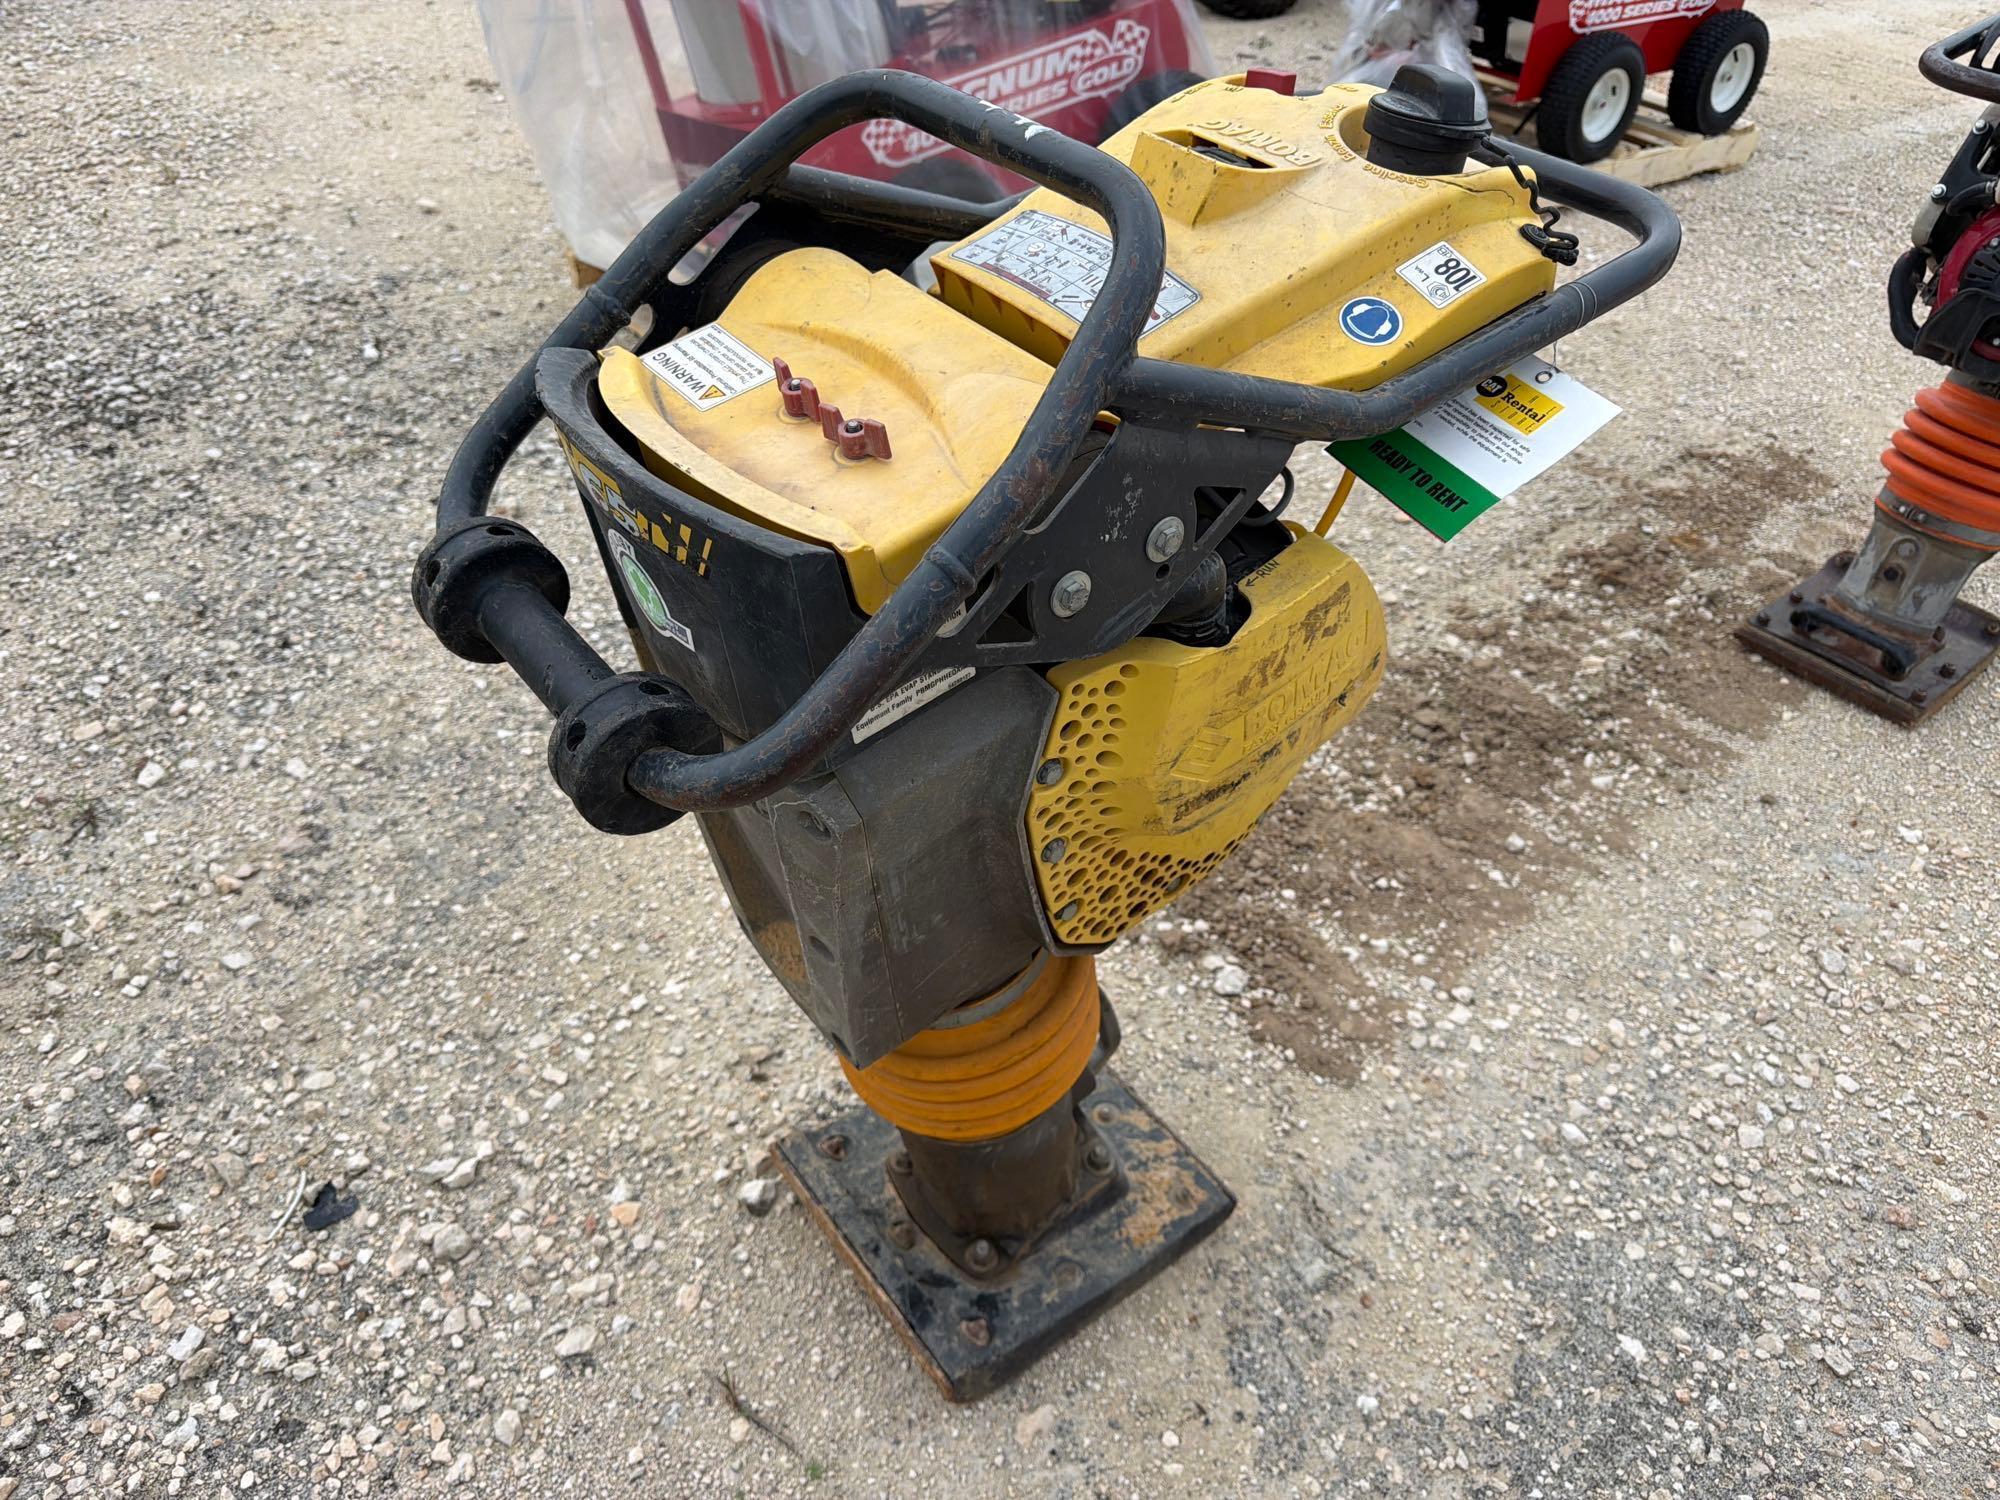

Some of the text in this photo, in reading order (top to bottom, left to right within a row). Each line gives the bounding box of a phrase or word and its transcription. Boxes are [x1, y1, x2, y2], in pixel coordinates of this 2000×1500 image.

[1075, 53, 1137, 90] GOLD
[1199, 117, 1321, 166] BOMAG
[1362, 162, 1430, 189] Gasoline
[1434, 257, 1478, 292] 108
[652, 351, 707, 394] WARNING
[1481, 378, 1503, 394] CAT
[1500, 391, 1547, 424] Rental
[1518, 443, 1531, 452] safe
[1369, 438, 1470, 513] READY TO RENT
[1257, 559, 1281, 580] RUN
[885, 690, 900, 703] EPA
[900, 680, 919, 694] EVAP
[855, 707, 892, 732] Equipment
[891, 694, 914, 711] Family
